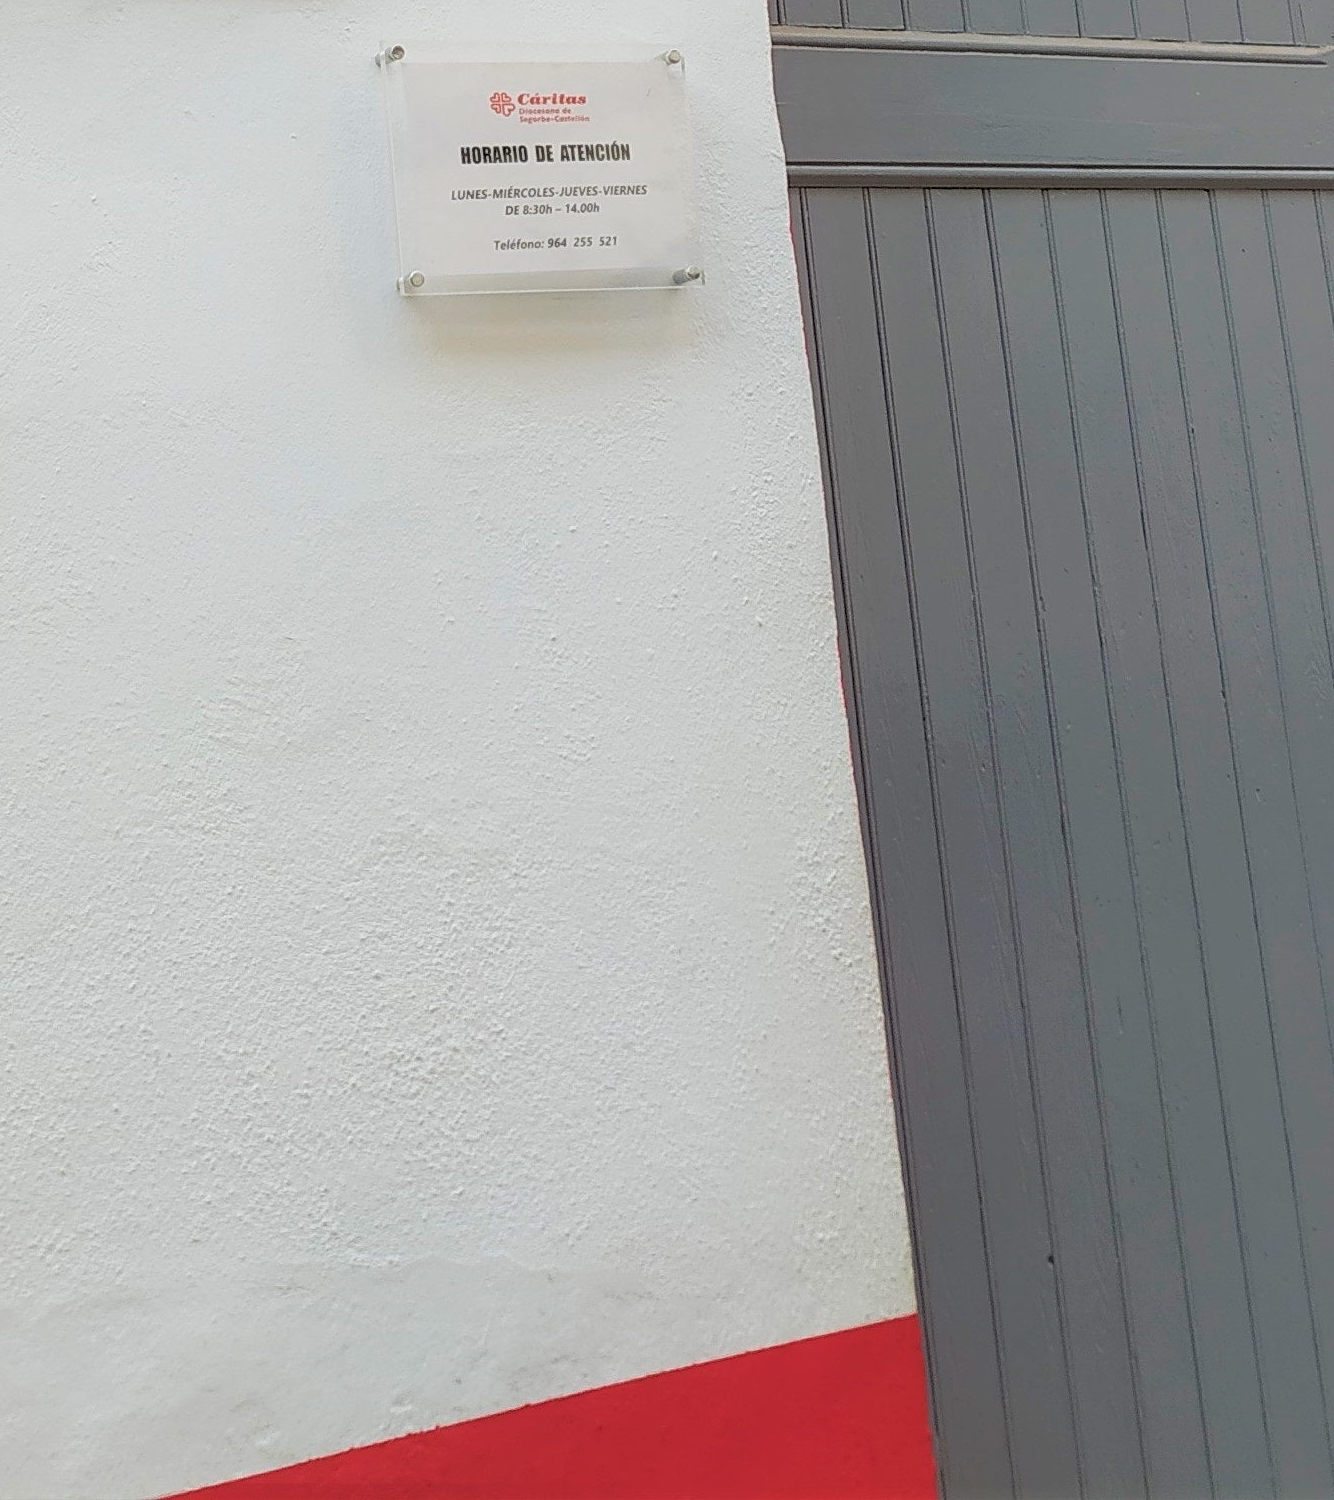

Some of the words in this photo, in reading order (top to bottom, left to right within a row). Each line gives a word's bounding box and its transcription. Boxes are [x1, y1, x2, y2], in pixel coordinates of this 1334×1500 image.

[517, 92, 587, 106] Cáritas
[460, 144, 528, 165] HORARIO
[535, 144, 554, 163] DE
[560, 140, 631, 162] ATENCIÓN
[450, 185, 648, 201] LUNES-MIÉRCOLES-JUEVES-VIERNES
[505, 205, 519, 216] DE
[493, 238, 545, 251] Teléfono:
[547, 237, 567, 249] 964
[573, 236, 593, 248] 255
[598, 235, 618, 247] 521
